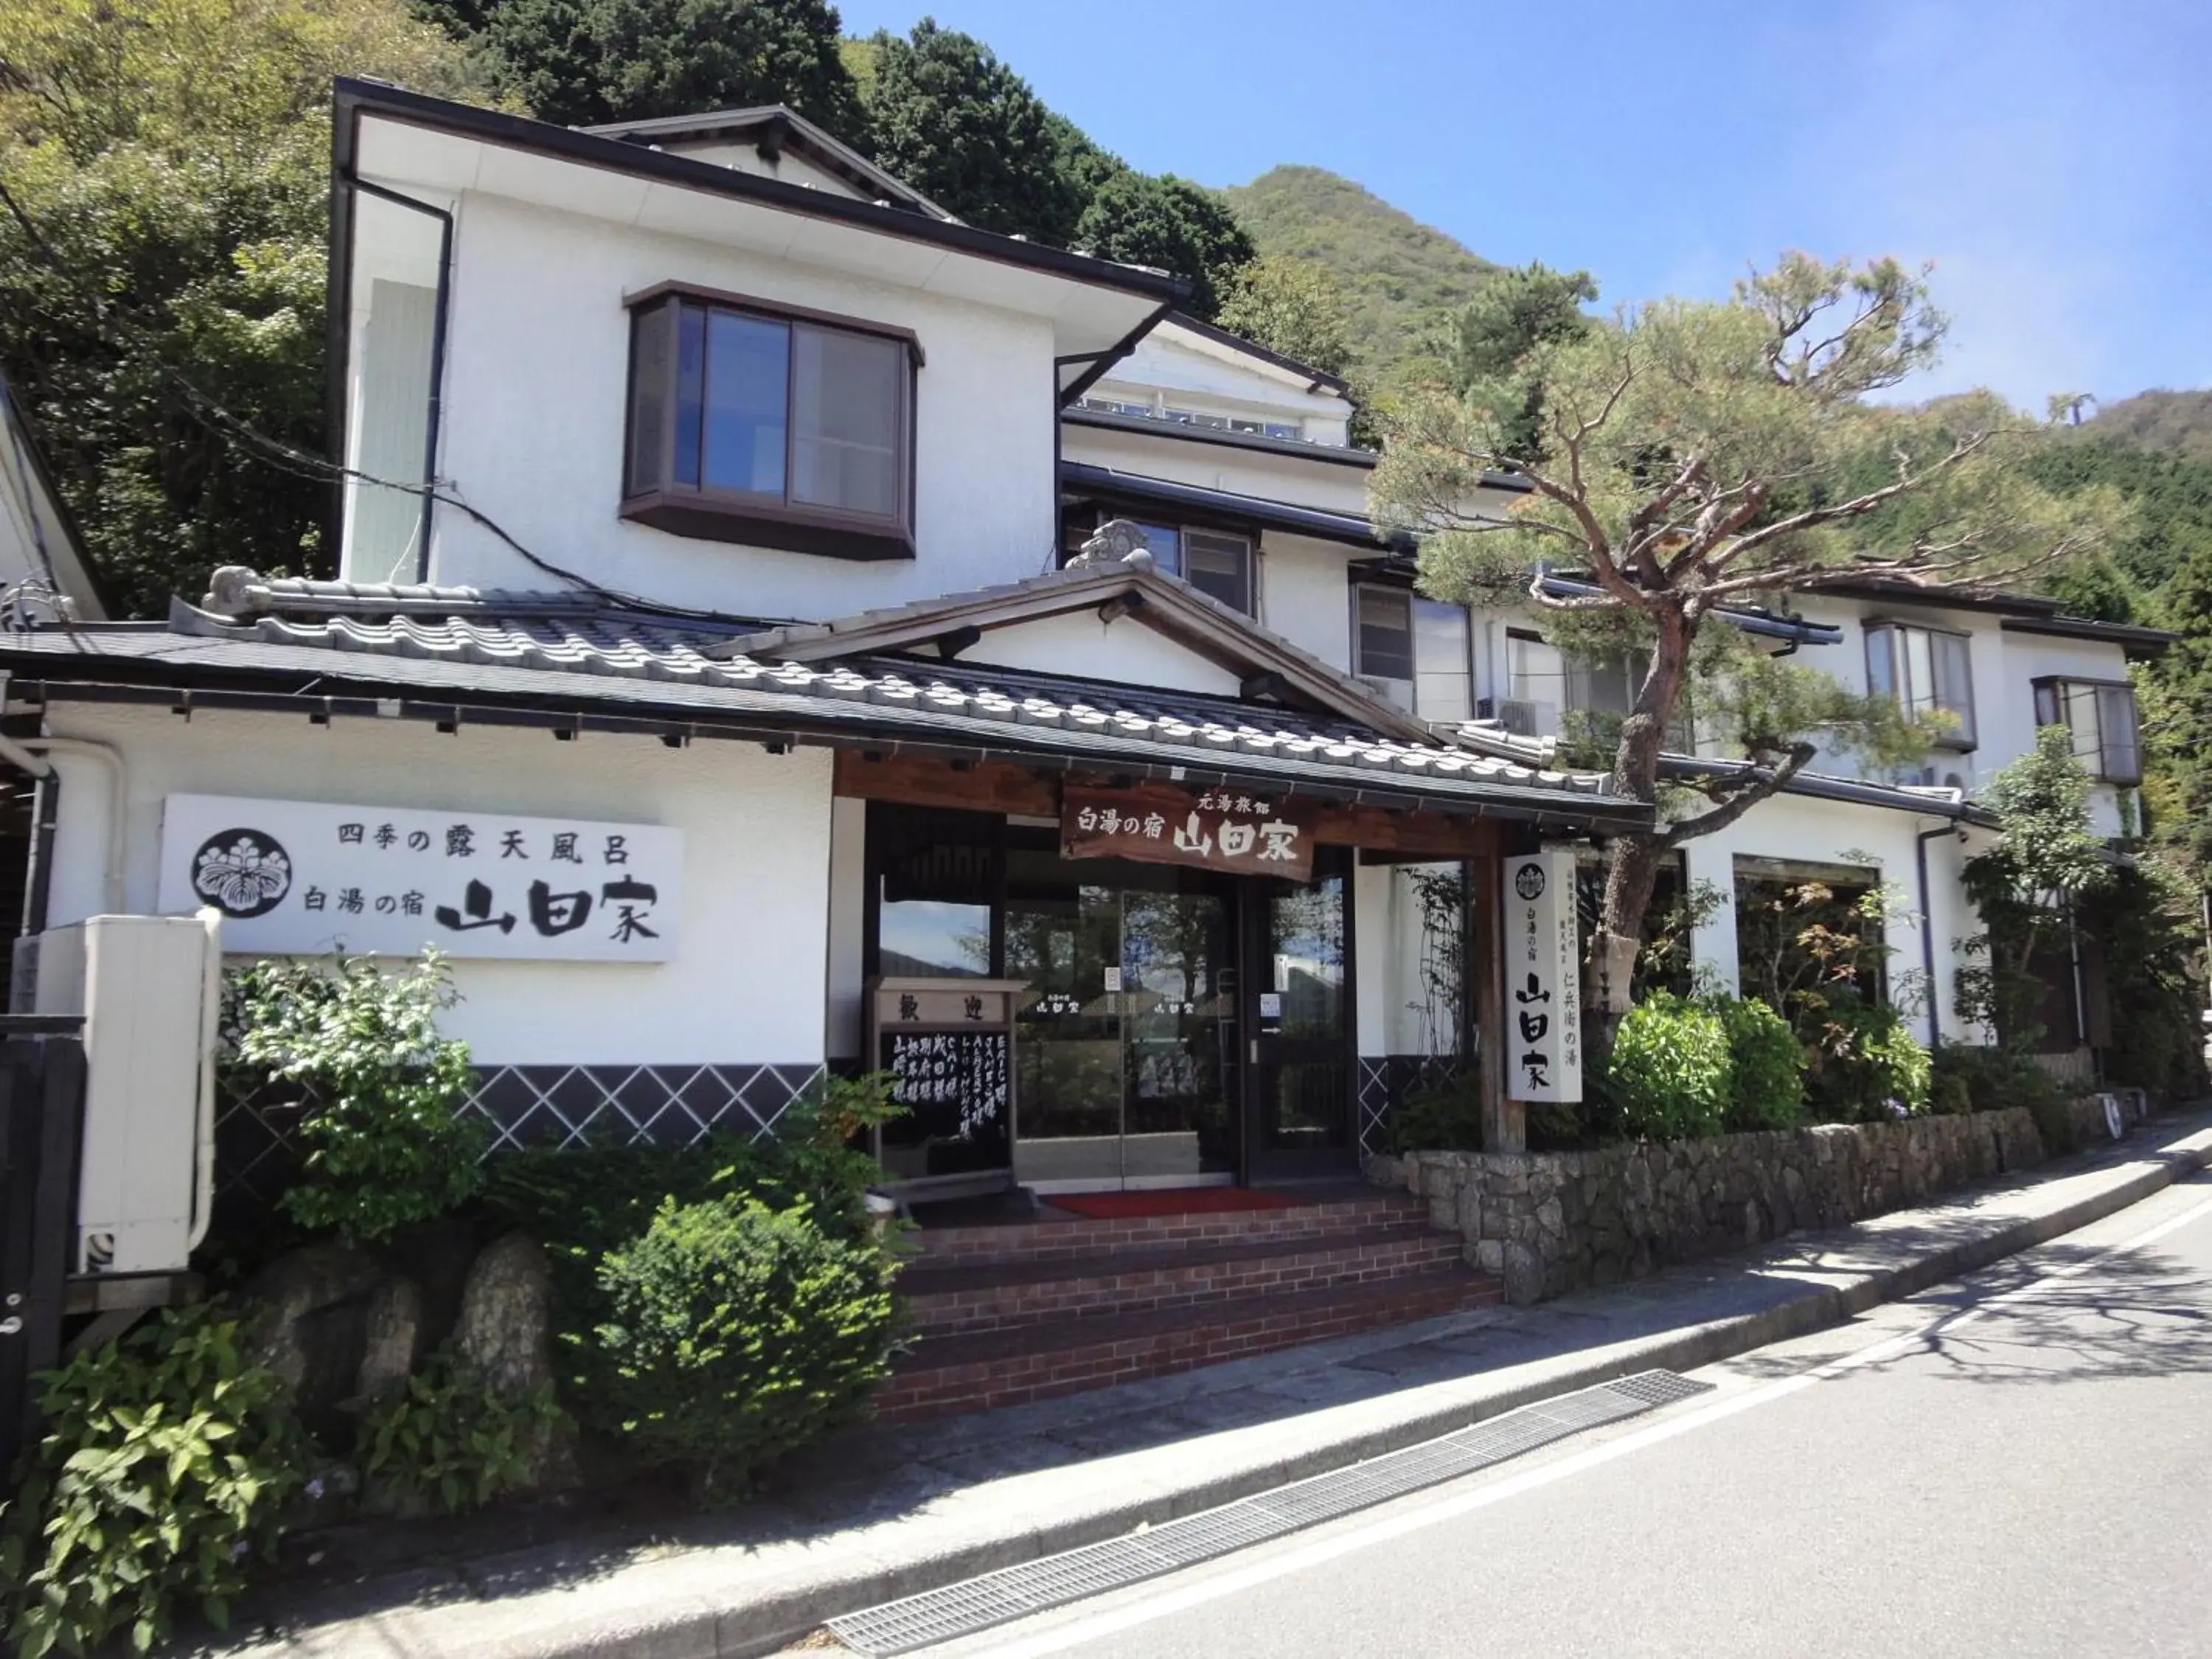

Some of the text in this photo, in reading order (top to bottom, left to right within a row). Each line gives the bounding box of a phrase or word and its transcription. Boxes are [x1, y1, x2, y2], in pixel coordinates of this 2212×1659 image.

[1197, 793, 1270, 815] 元湯旅館
[338, 823, 630, 864] 四季の露天風呂
[1077, 807, 1298, 861] 白湯の宿 山田家
[304, 874, 659, 943] 白湯の宿 山田家
[1514, 971, 1551, 1091] 山田家
